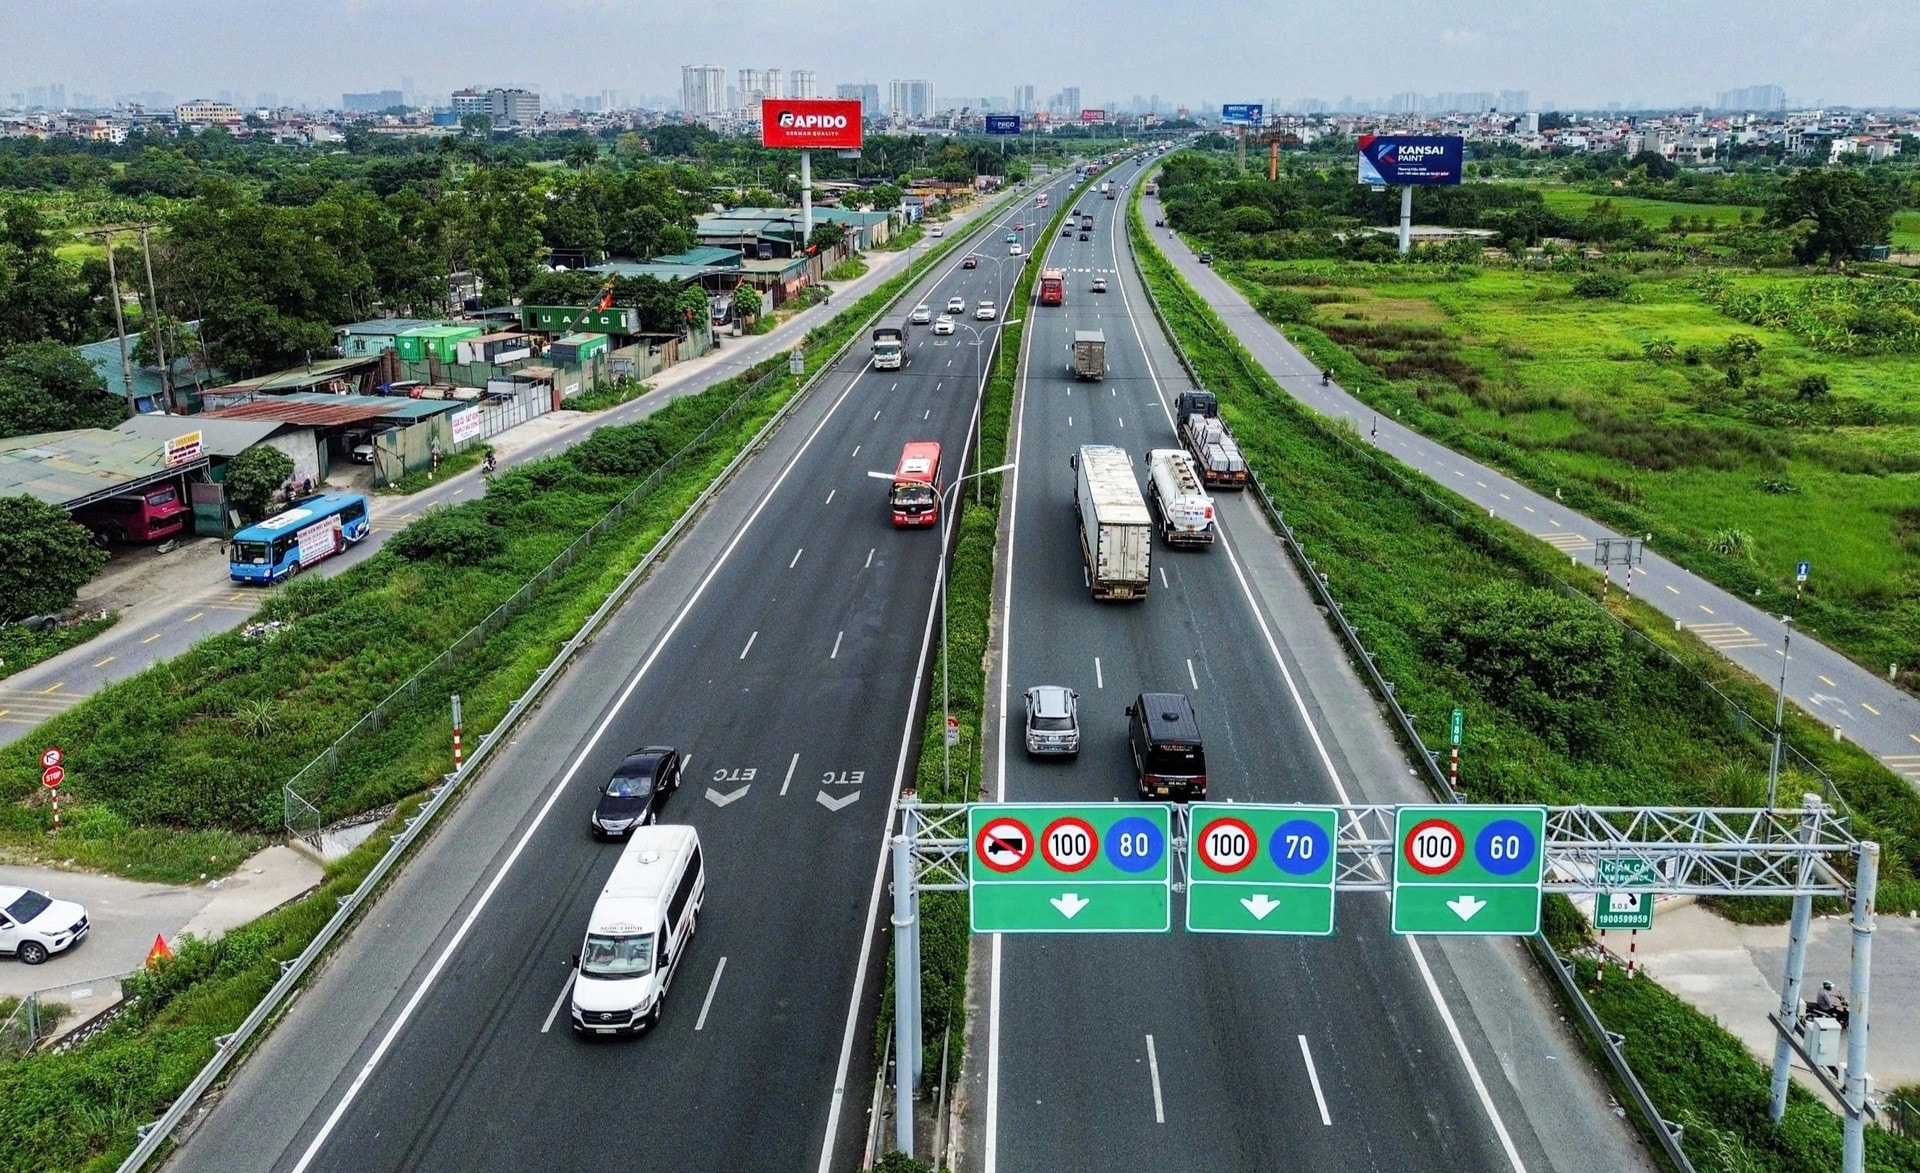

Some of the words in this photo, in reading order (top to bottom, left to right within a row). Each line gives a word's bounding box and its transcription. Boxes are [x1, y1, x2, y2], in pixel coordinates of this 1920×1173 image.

[780, 113, 848, 129] RAPIDO
[1397, 154, 1424, 162] PAINT
[1398, 145, 1444, 155] KANSAI
[45, 770, 62, 783] STOP
[713, 768, 758, 782] ETC
[821, 771, 866, 785] ETC
[1052, 833, 1087, 857] 100
[1119, 832, 1149, 858] 80
[1211, 833, 1246, 857] 100
[1285, 835, 1313, 860] 70
[1417, 835, 1453, 859] 100
[1490, 835, 1520, 860] 60
[1599, 914, 1648, 924] 1900599959
